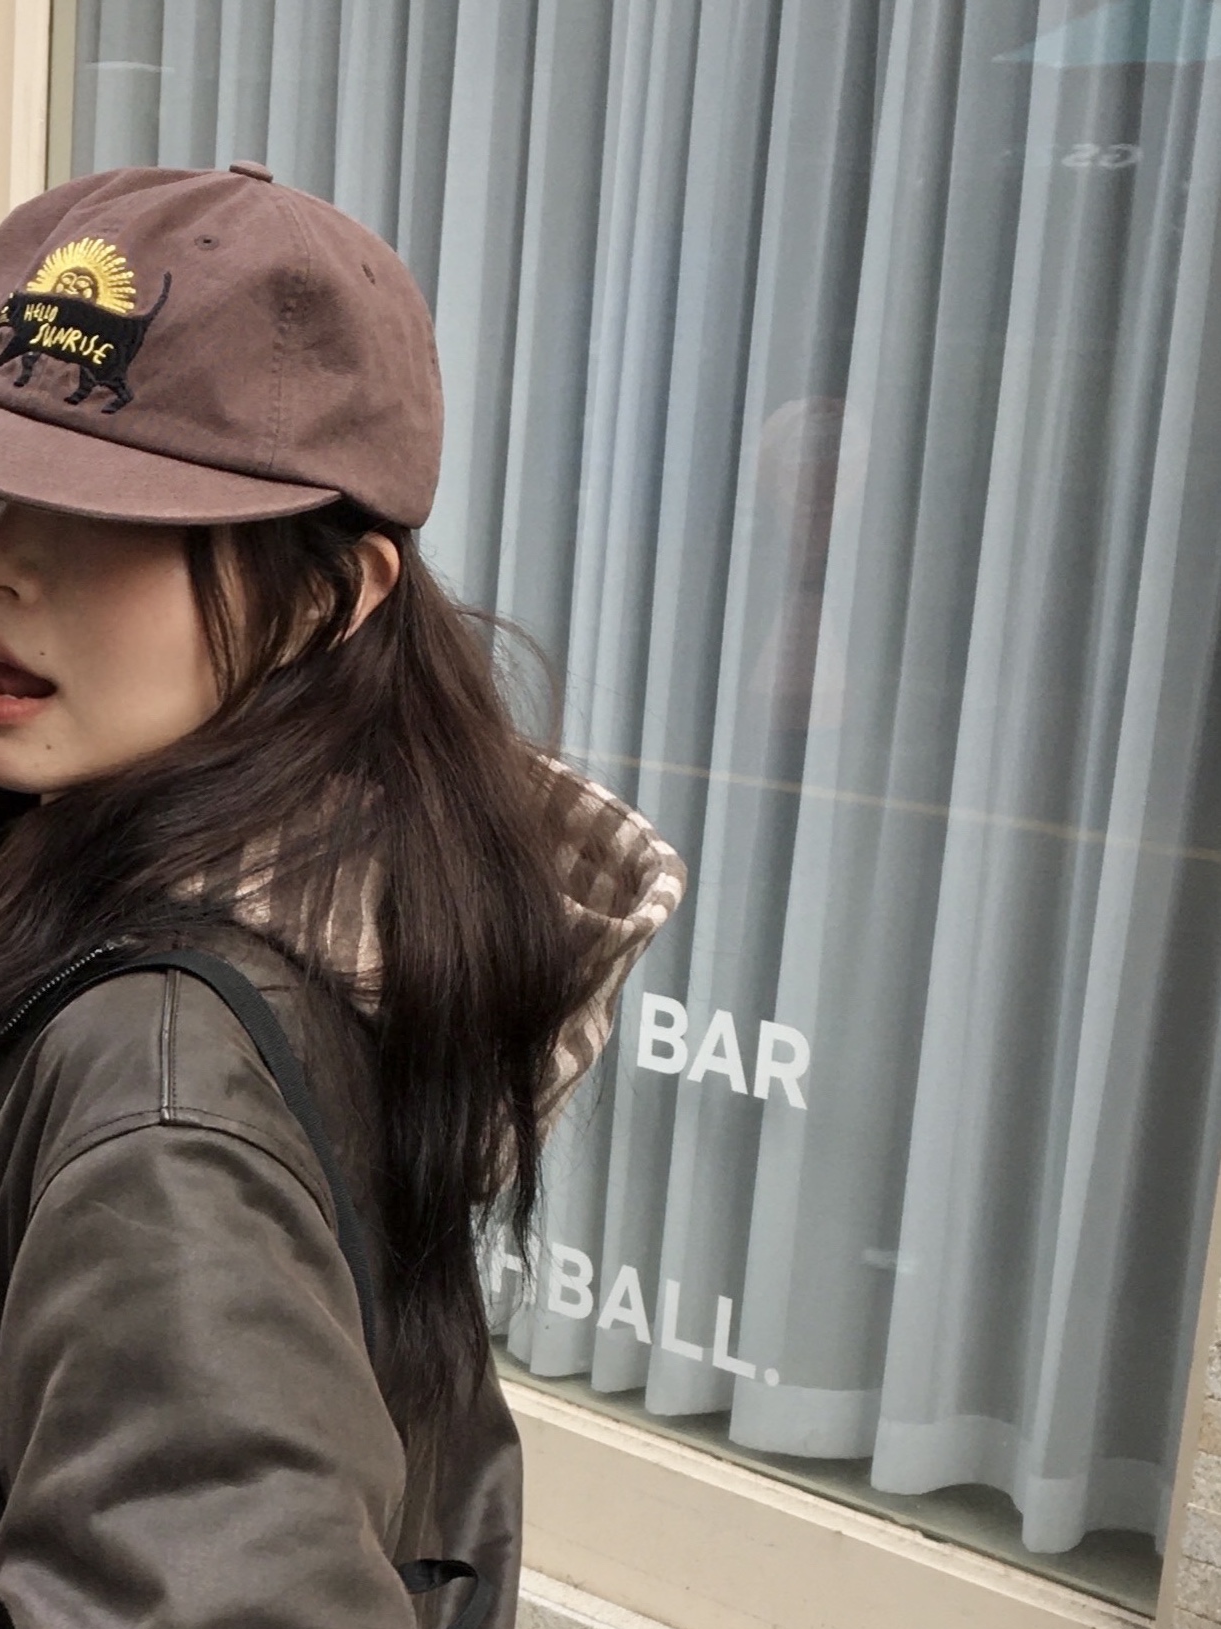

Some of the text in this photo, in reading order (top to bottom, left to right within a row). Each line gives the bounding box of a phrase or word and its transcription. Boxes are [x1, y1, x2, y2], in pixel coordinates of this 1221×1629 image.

[24, 302, 59, 322] HELLO
[29, 323, 115, 365] SUNRISE
[636, 991, 811, 1110] BAR
